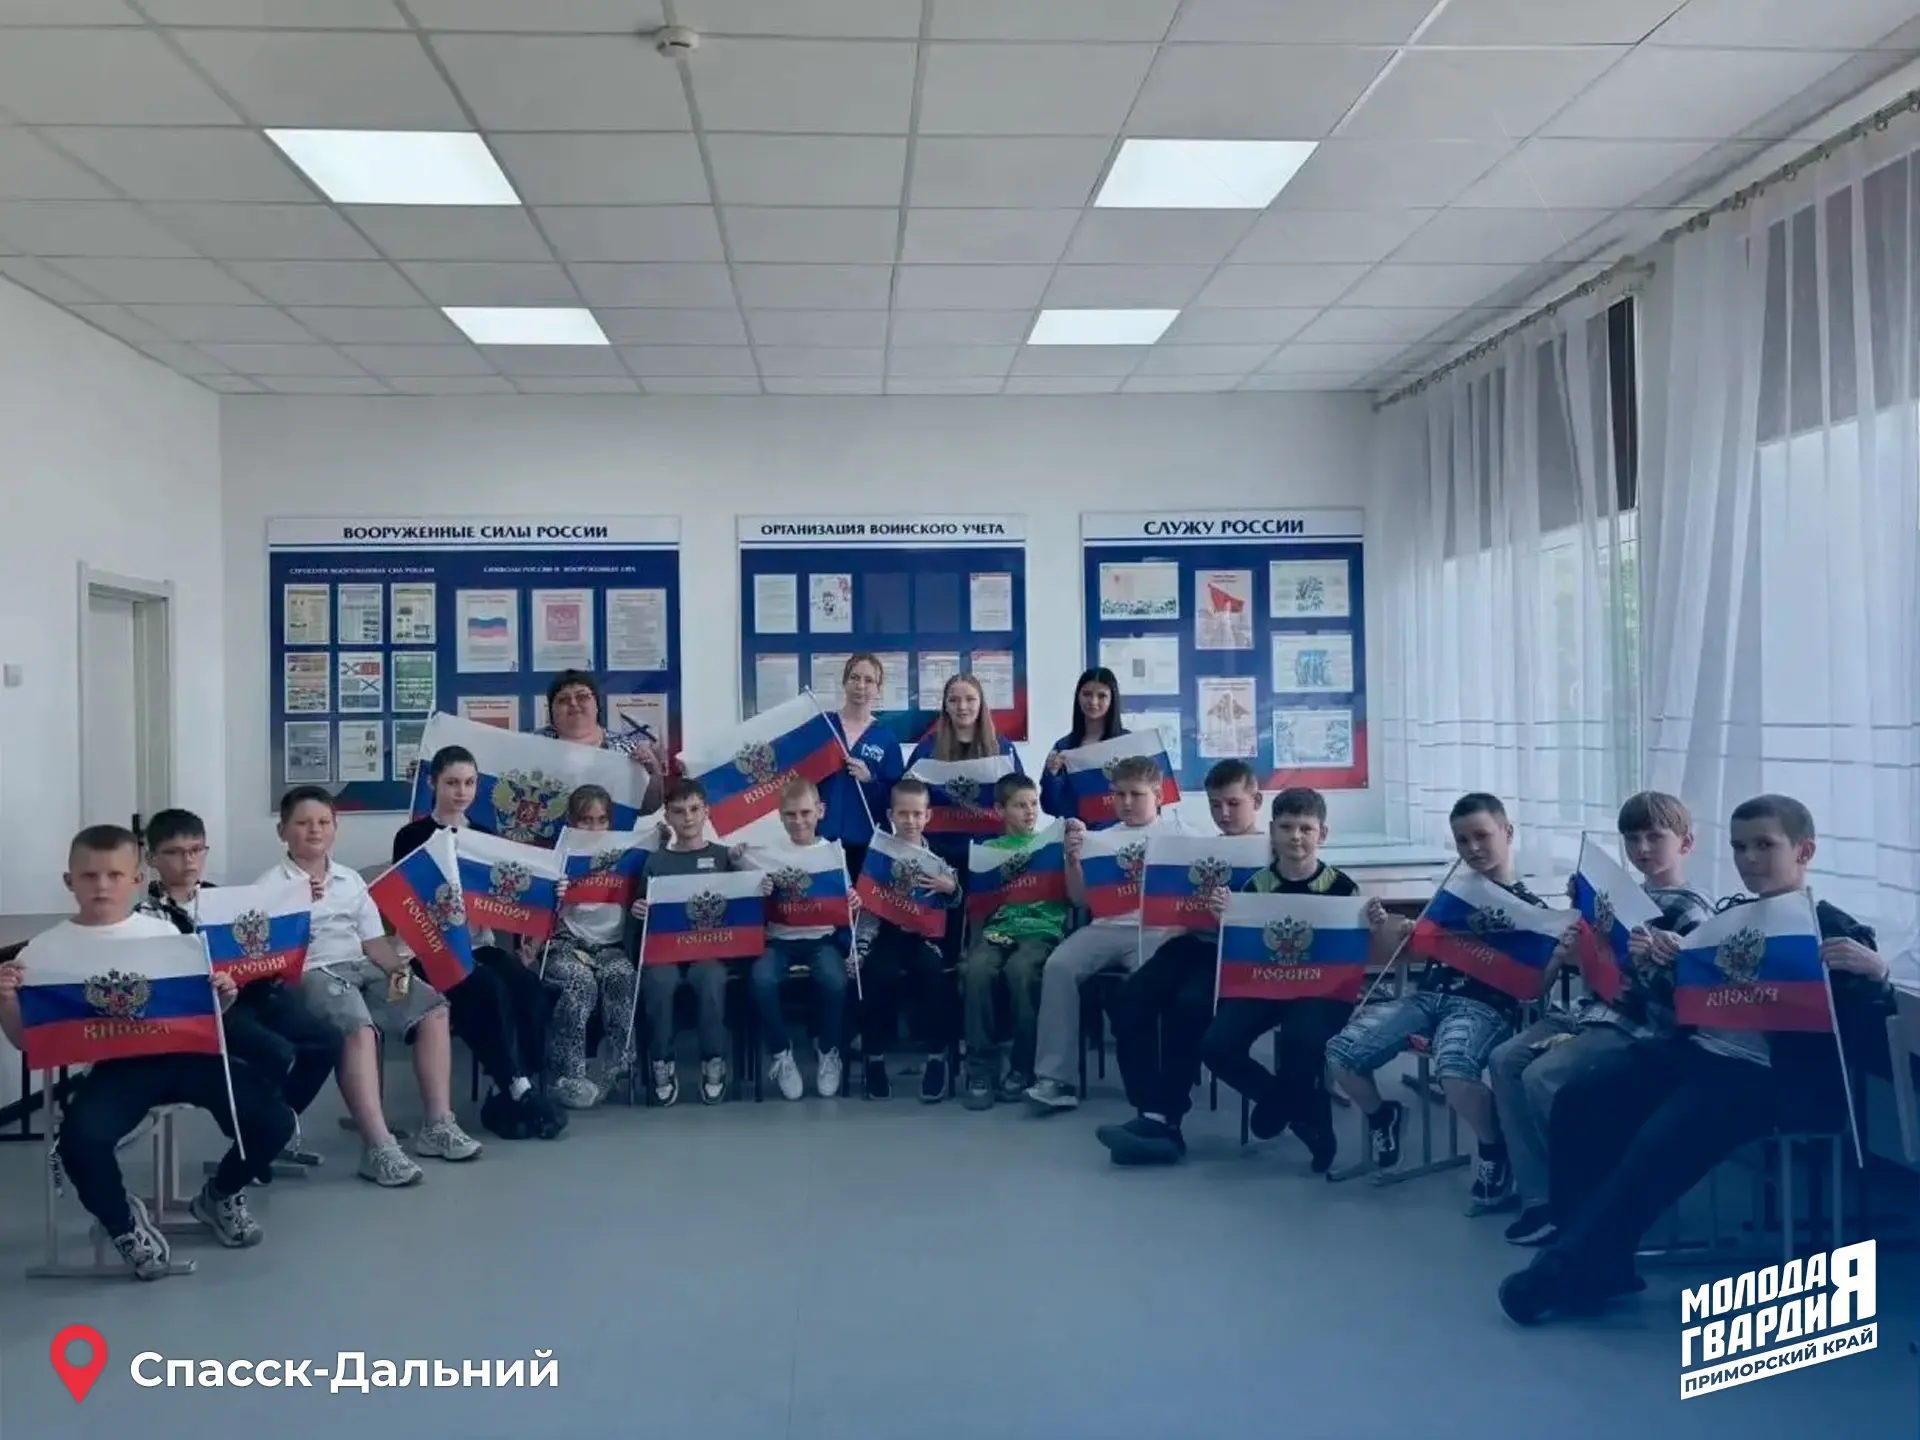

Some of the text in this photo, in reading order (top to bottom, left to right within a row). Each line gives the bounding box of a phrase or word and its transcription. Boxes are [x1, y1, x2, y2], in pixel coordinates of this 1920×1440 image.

[342, 525, 609, 540] ВООРУЖЕННЫЕ СИЛЫ РОССИИ
[760, 522, 1006, 536] ОРГАНИЗАЦИЯ ВОИНСКОГО УЧЕТА
[1143, 518, 1305, 536] СЛУЖУ РОССИИ
[1252, 967, 1321, 981] РОССИЯ
